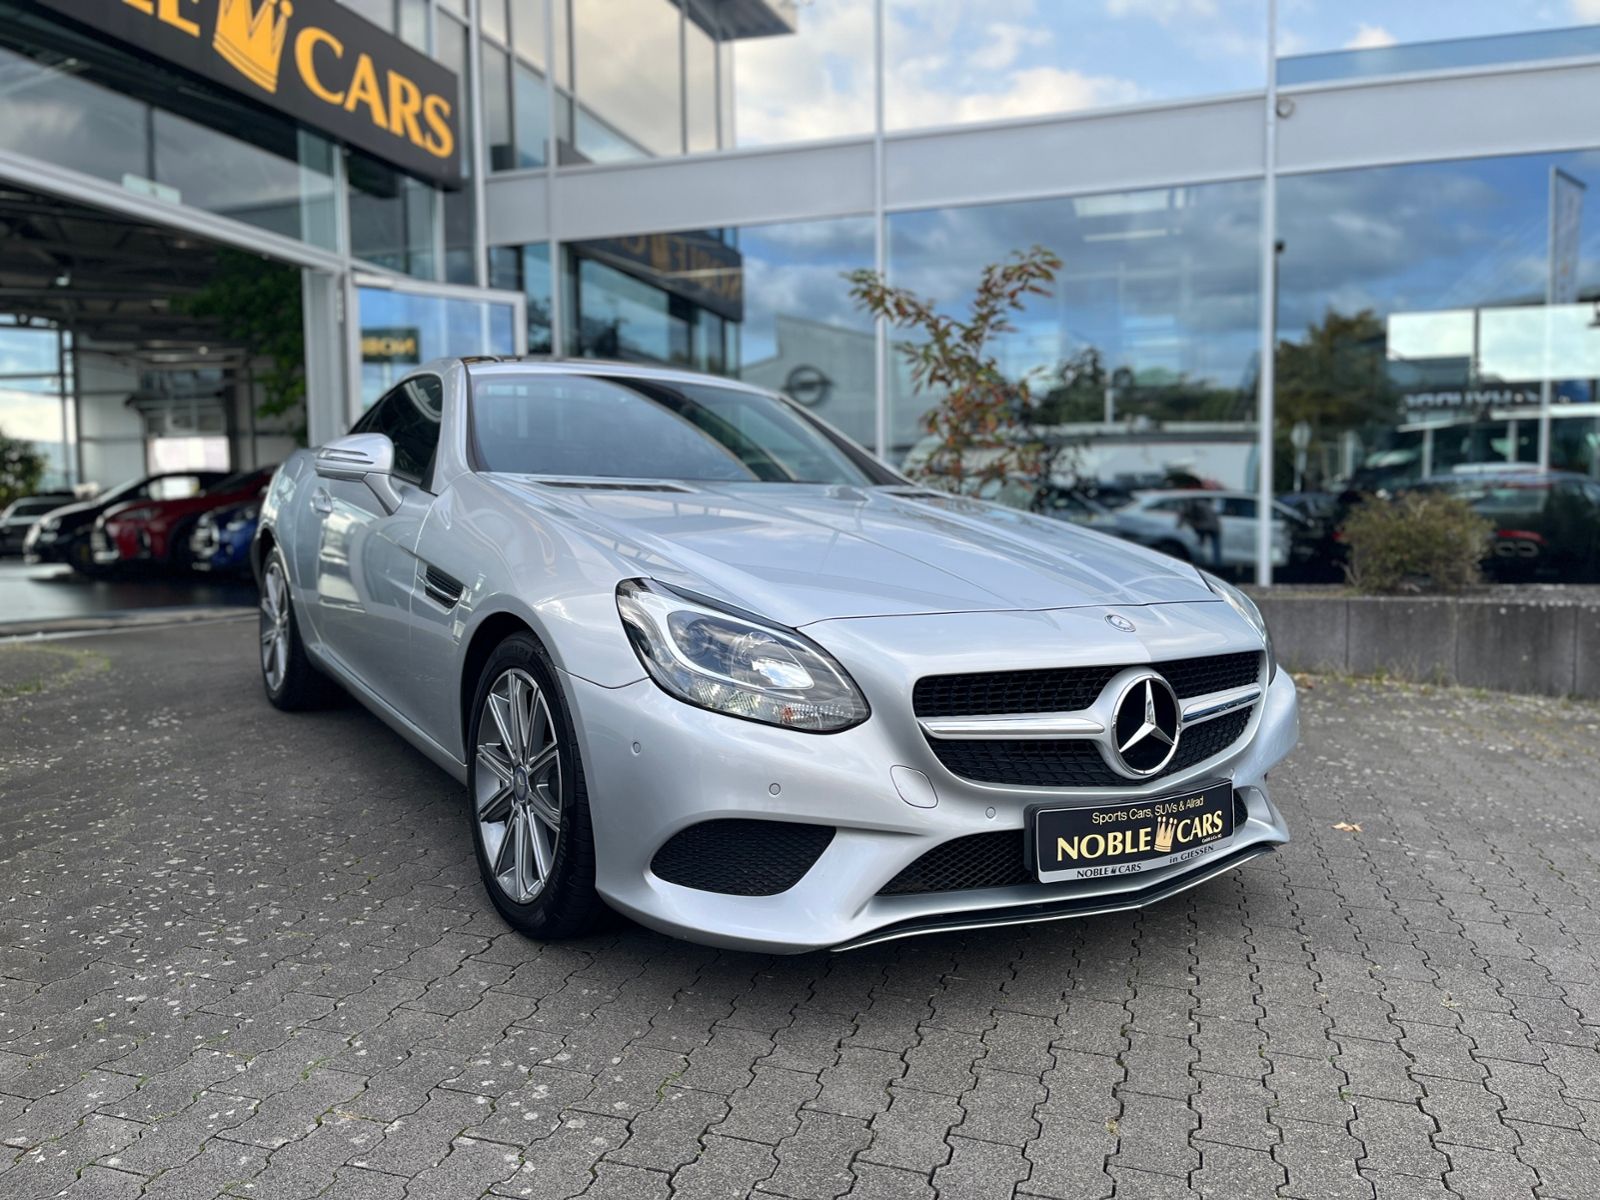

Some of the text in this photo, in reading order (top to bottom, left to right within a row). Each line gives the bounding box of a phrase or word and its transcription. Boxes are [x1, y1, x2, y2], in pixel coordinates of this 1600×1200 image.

[294, 26, 454, 158] CARS
[1092, 811, 1127, 825] Sports
[1129, 808, 1154, 820] Cars,
[1155, 802, 1178, 816] SUVs
[1179, 801, 1185, 811] &
[1057, 810, 1223, 861] NOBLE CARS
[1076, 845, 1213, 878] NOBLE CARS in GIESSEN
